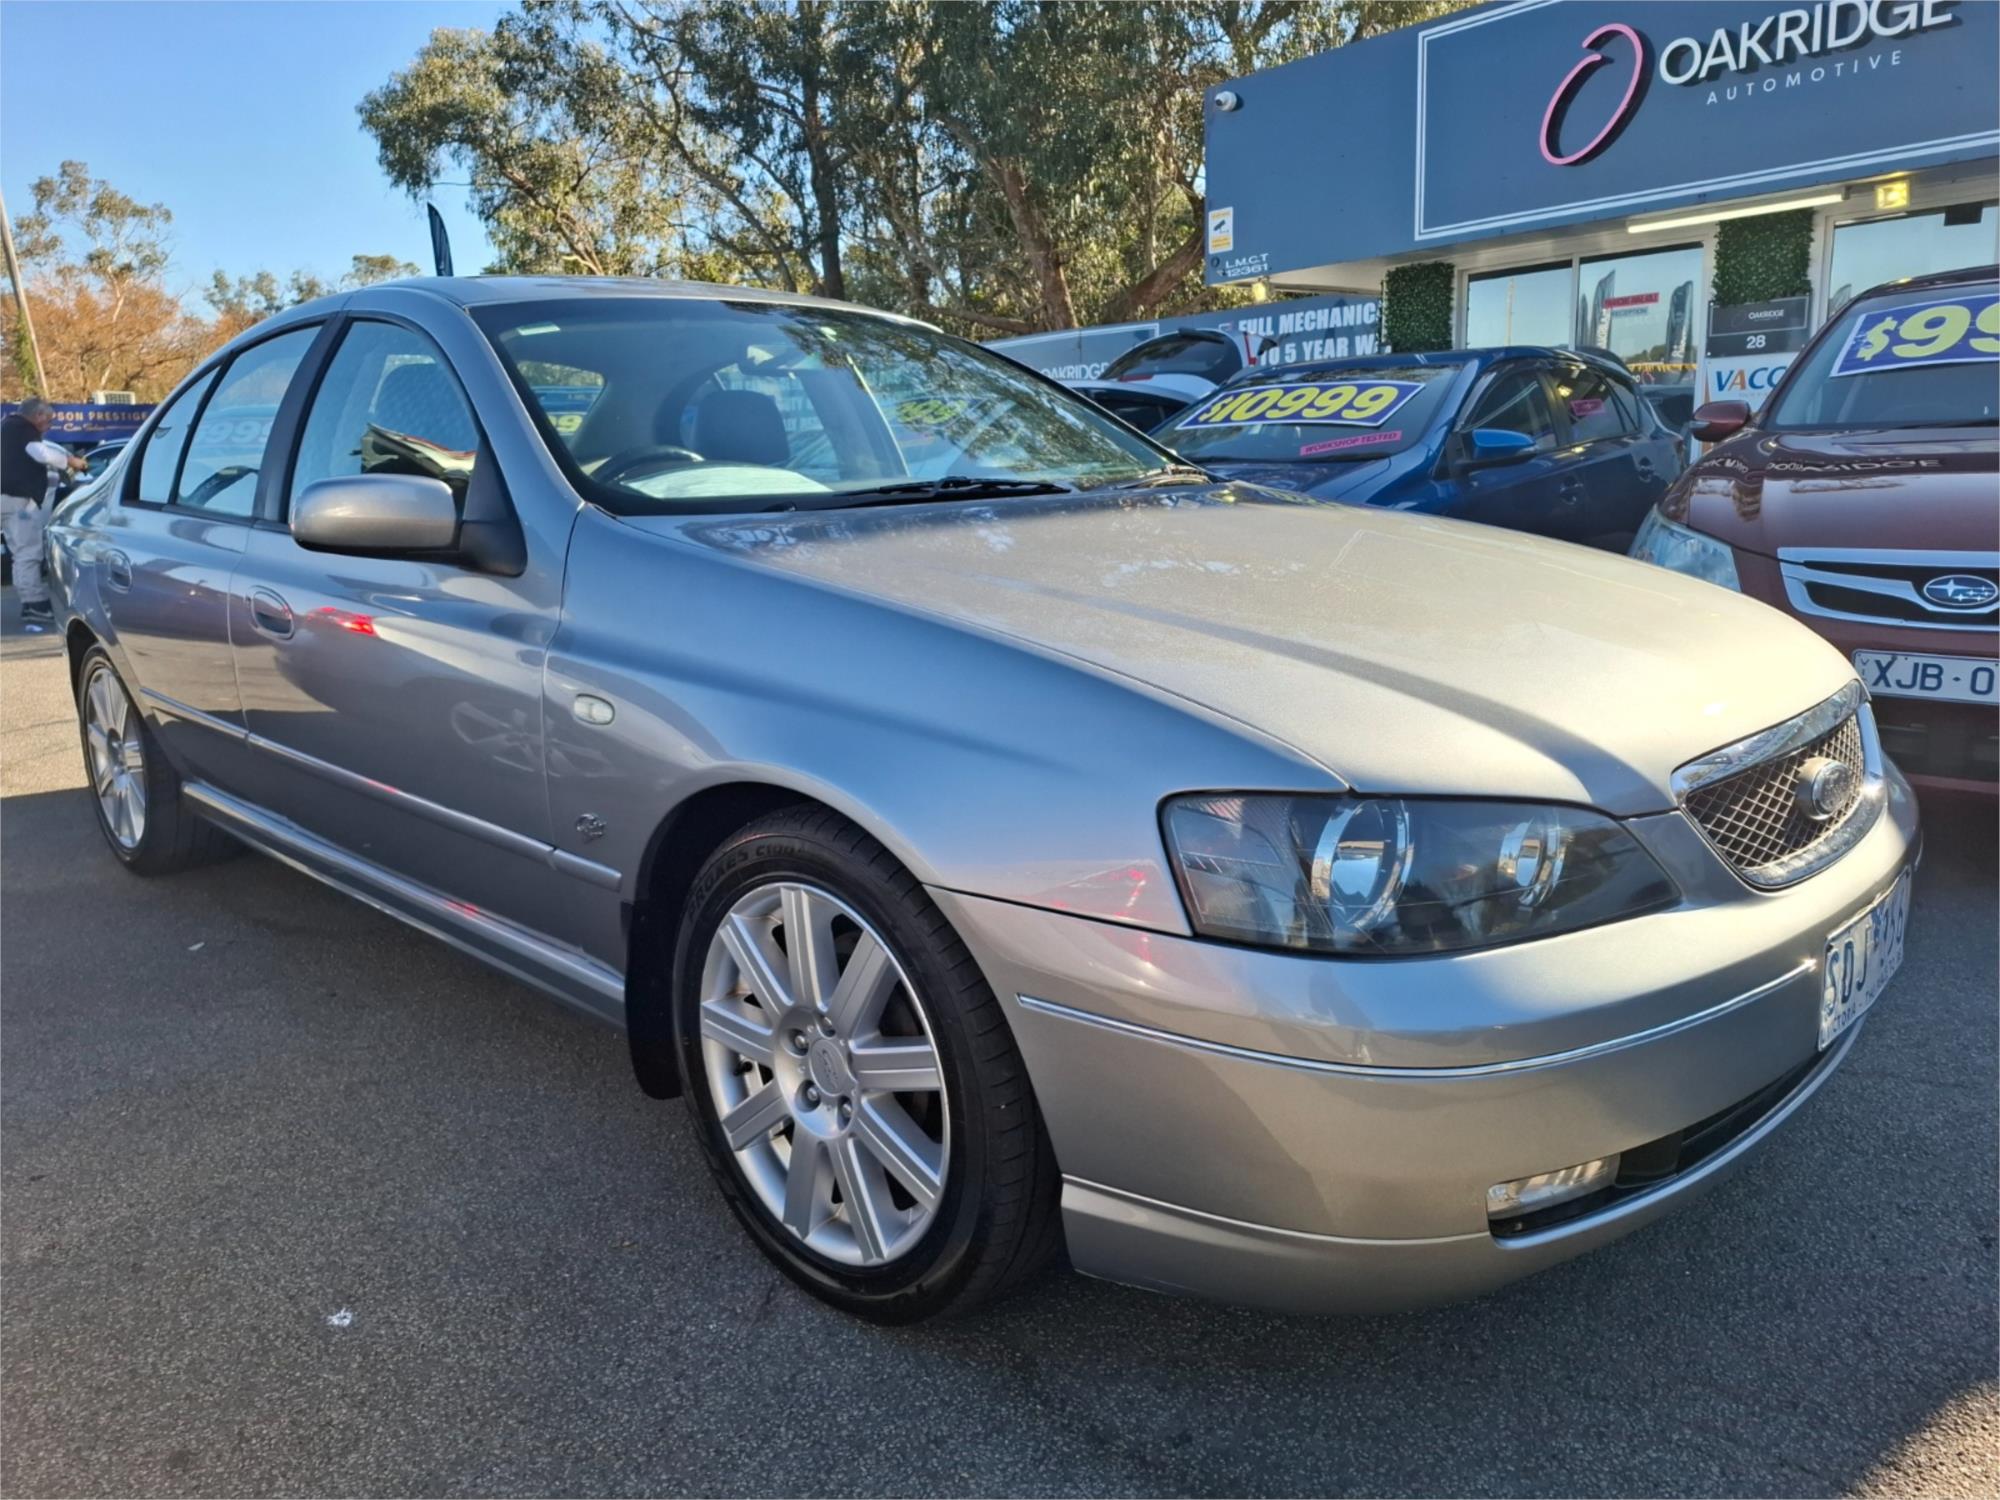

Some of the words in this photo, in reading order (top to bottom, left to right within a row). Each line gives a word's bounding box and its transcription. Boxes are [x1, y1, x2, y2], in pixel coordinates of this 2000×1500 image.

[1705, 50, 1903, 105] AUTOMOTIVE
[1238, 315, 1275, 337] FULL
[1284, 342, 1297, 364] 5
[1302, 337, 1349, 361] YEAR
[1746, 334, 1766, 349] 28
[1715, 365, 1788, 392] VACC
[1198, 385, 1399, 423] $10999
